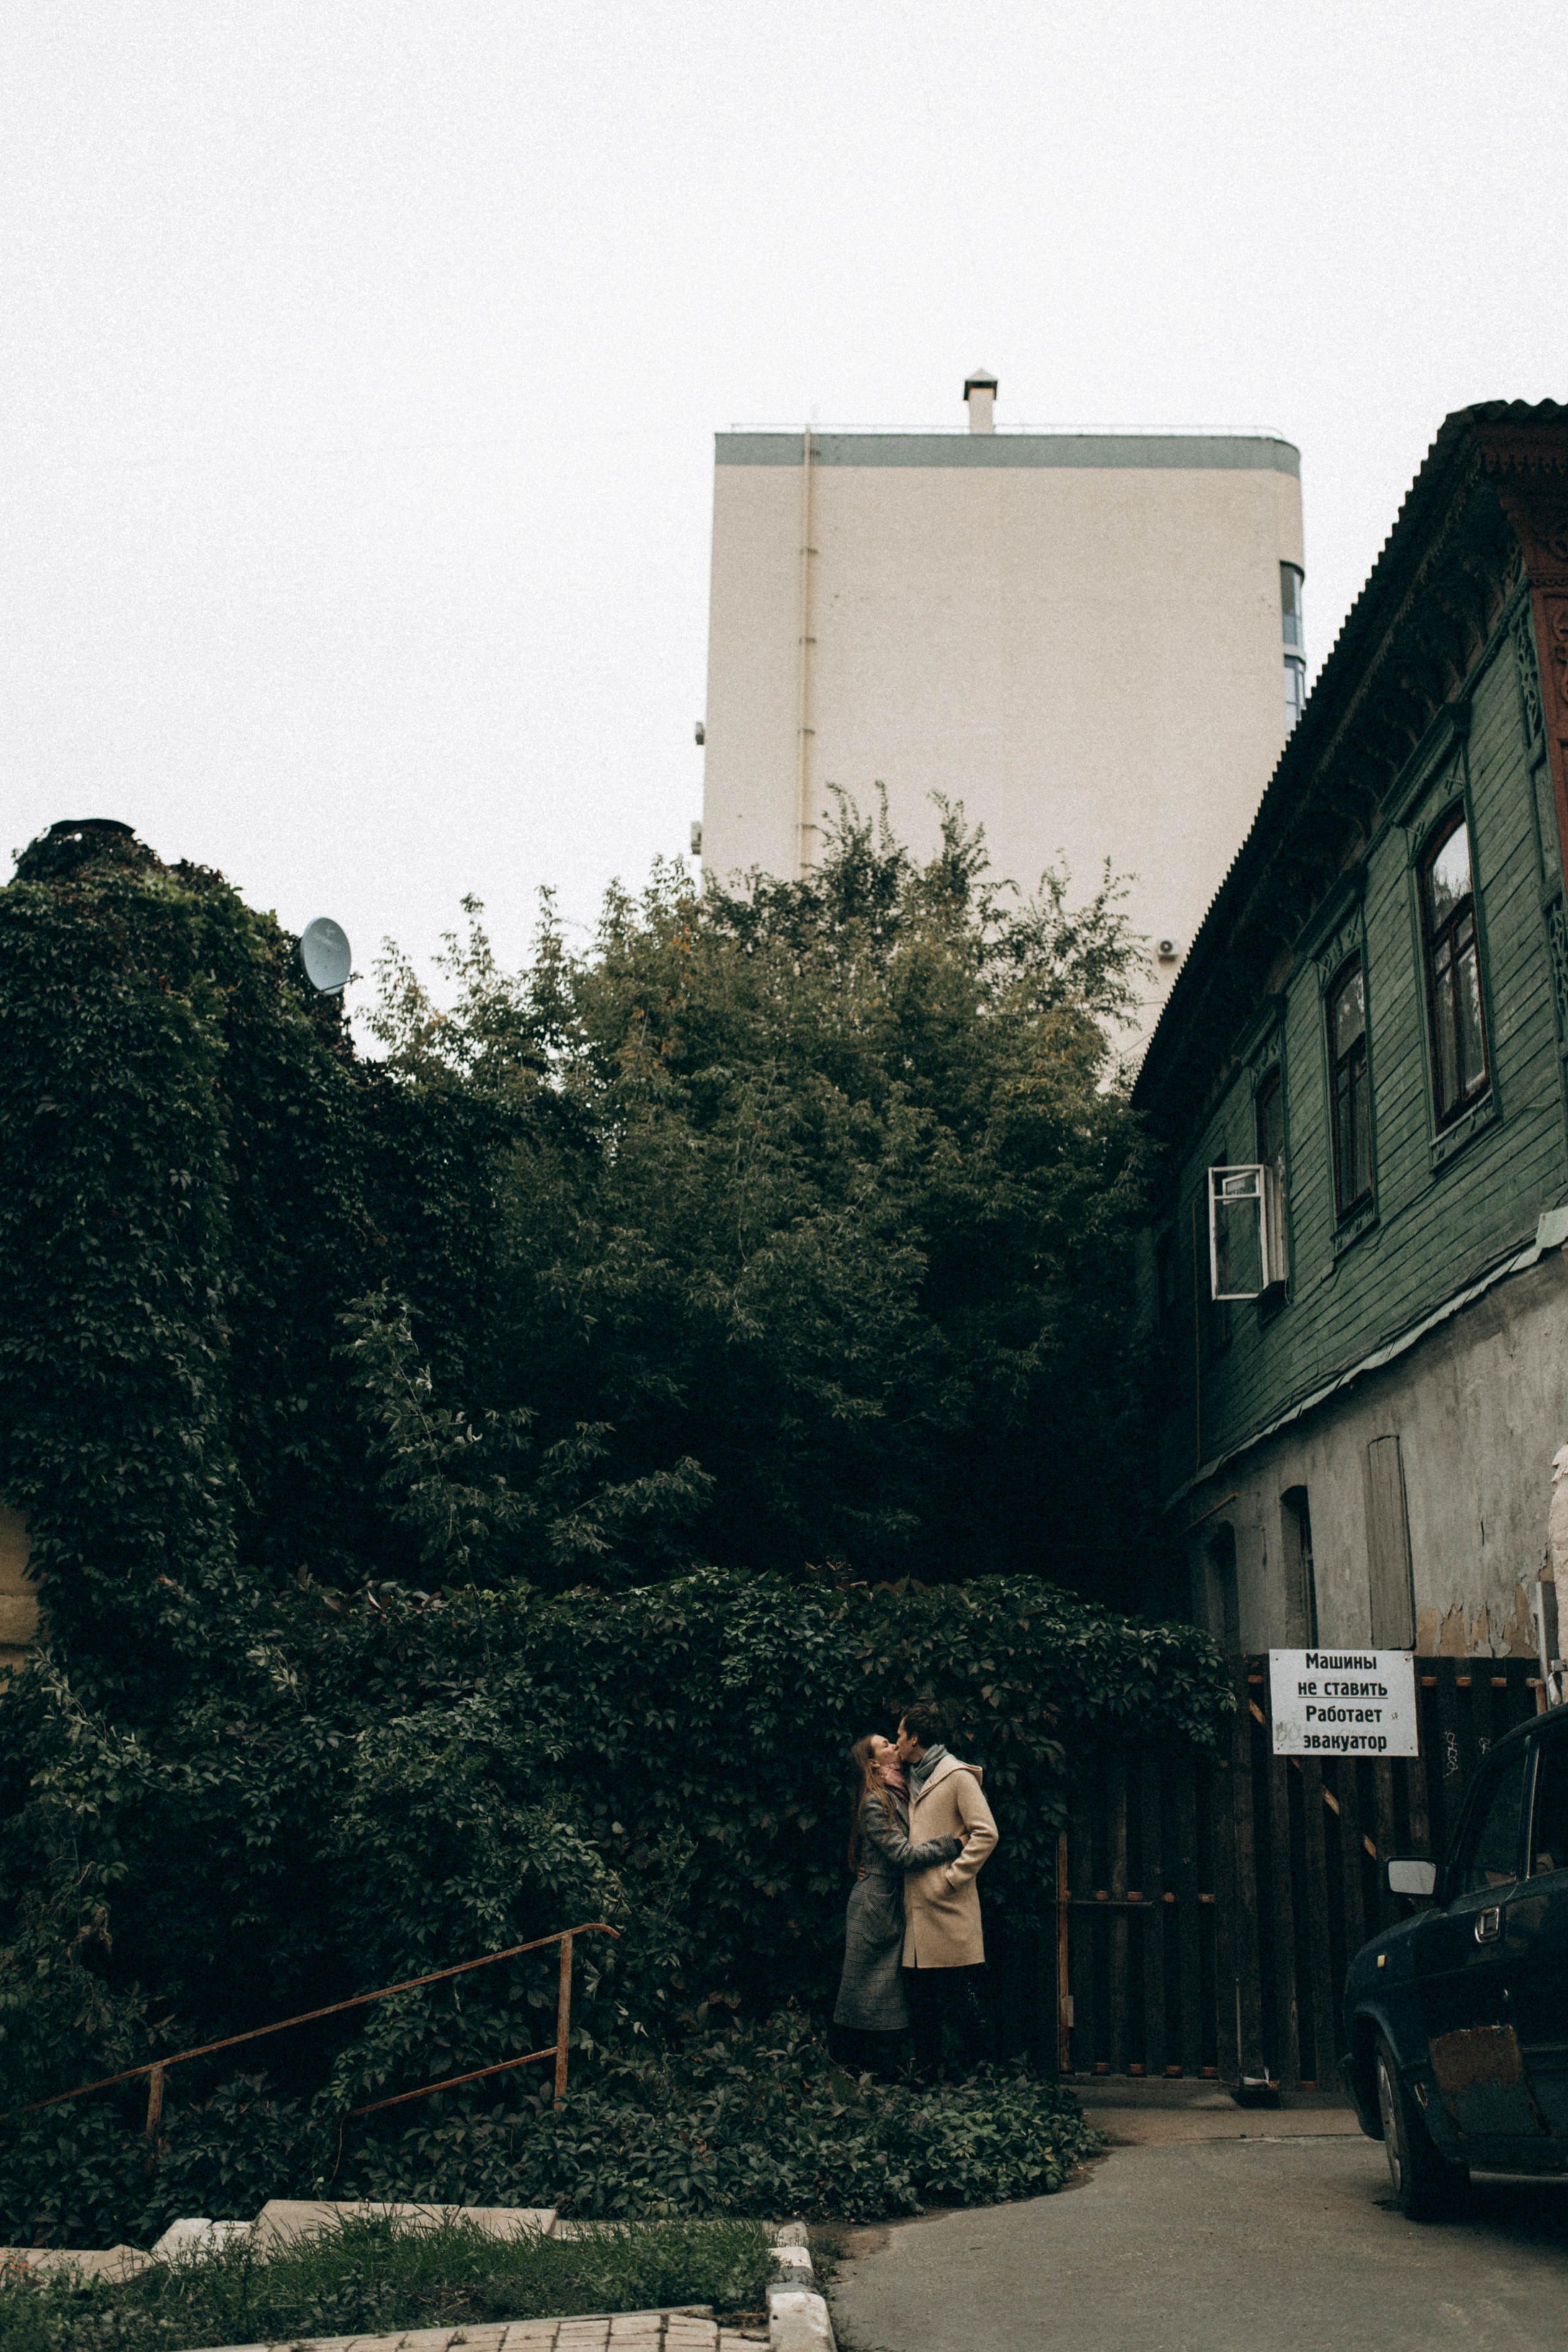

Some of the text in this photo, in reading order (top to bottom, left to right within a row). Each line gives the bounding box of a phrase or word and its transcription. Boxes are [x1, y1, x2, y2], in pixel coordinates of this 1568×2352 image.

[1306, 1653, 1376, 1669] Машины
[1298, 1683, 1387, 1696] не ставить
[1306, 1706, 1382, 1722] Работает
[1304, 1735, 1387, 1752] эвакуатор
